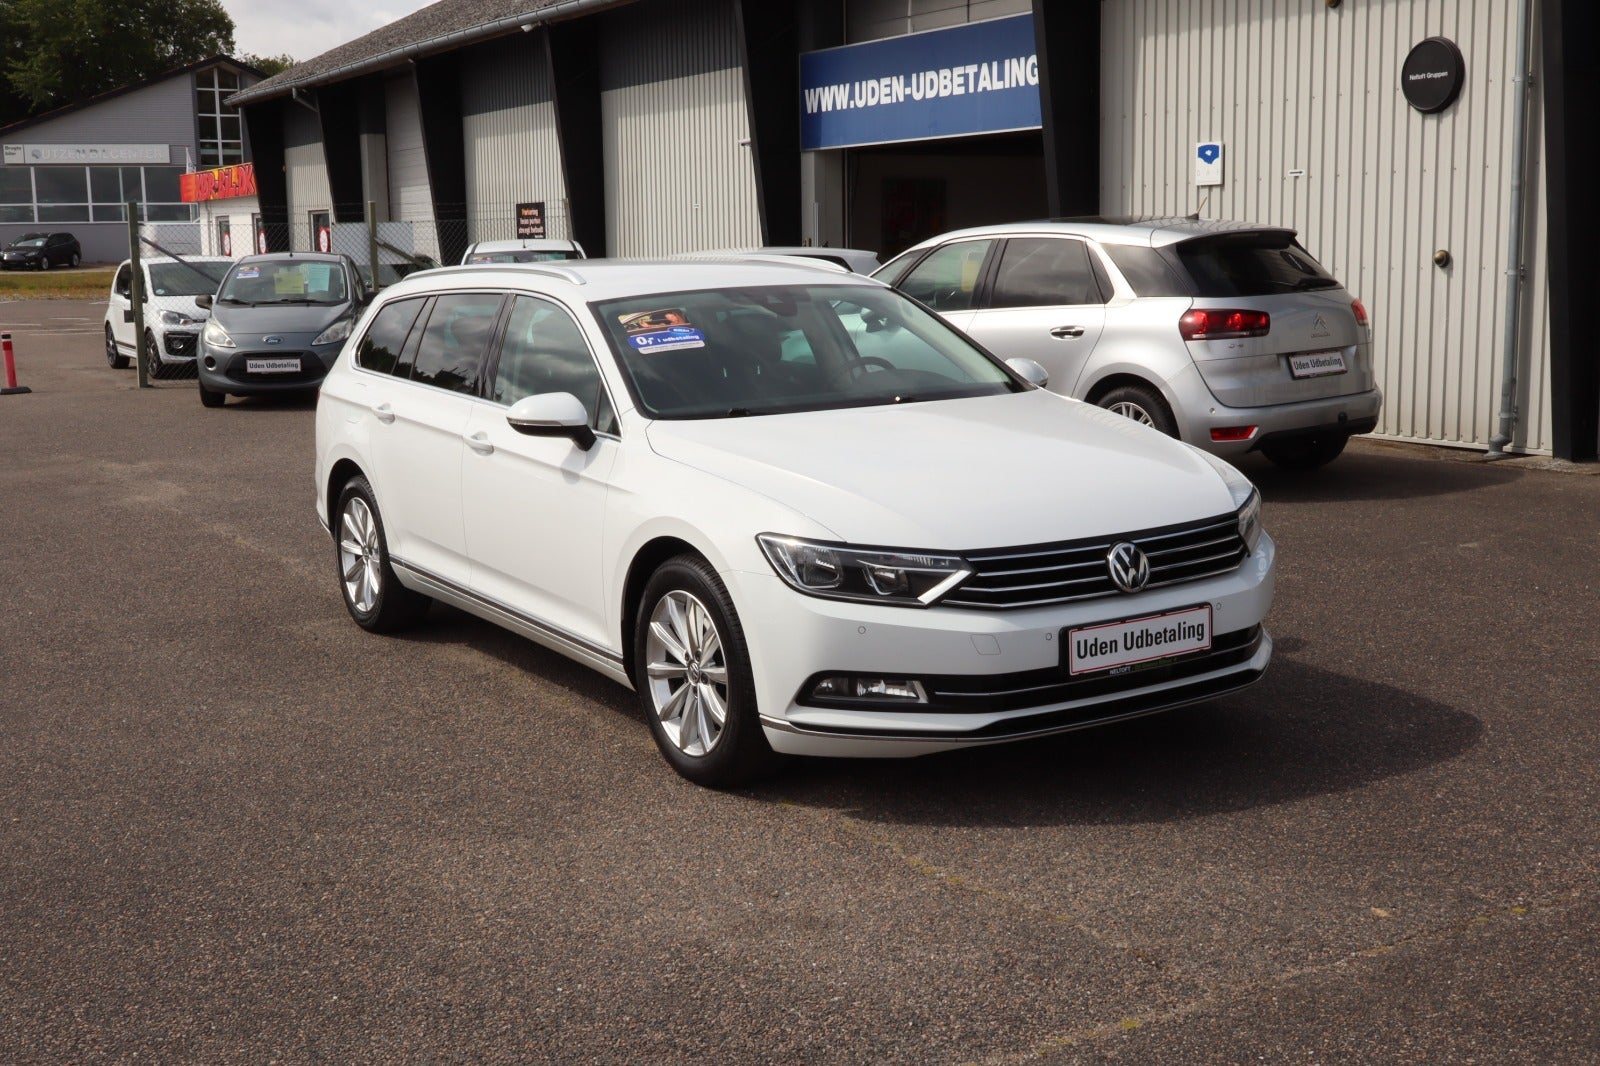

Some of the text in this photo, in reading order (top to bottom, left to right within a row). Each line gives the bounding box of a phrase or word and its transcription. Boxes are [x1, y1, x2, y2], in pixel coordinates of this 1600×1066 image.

[1293, 356, 1343, 370] Uden Udbetaling
[1076, 621, 1205, 660] Uden Udbetaling
